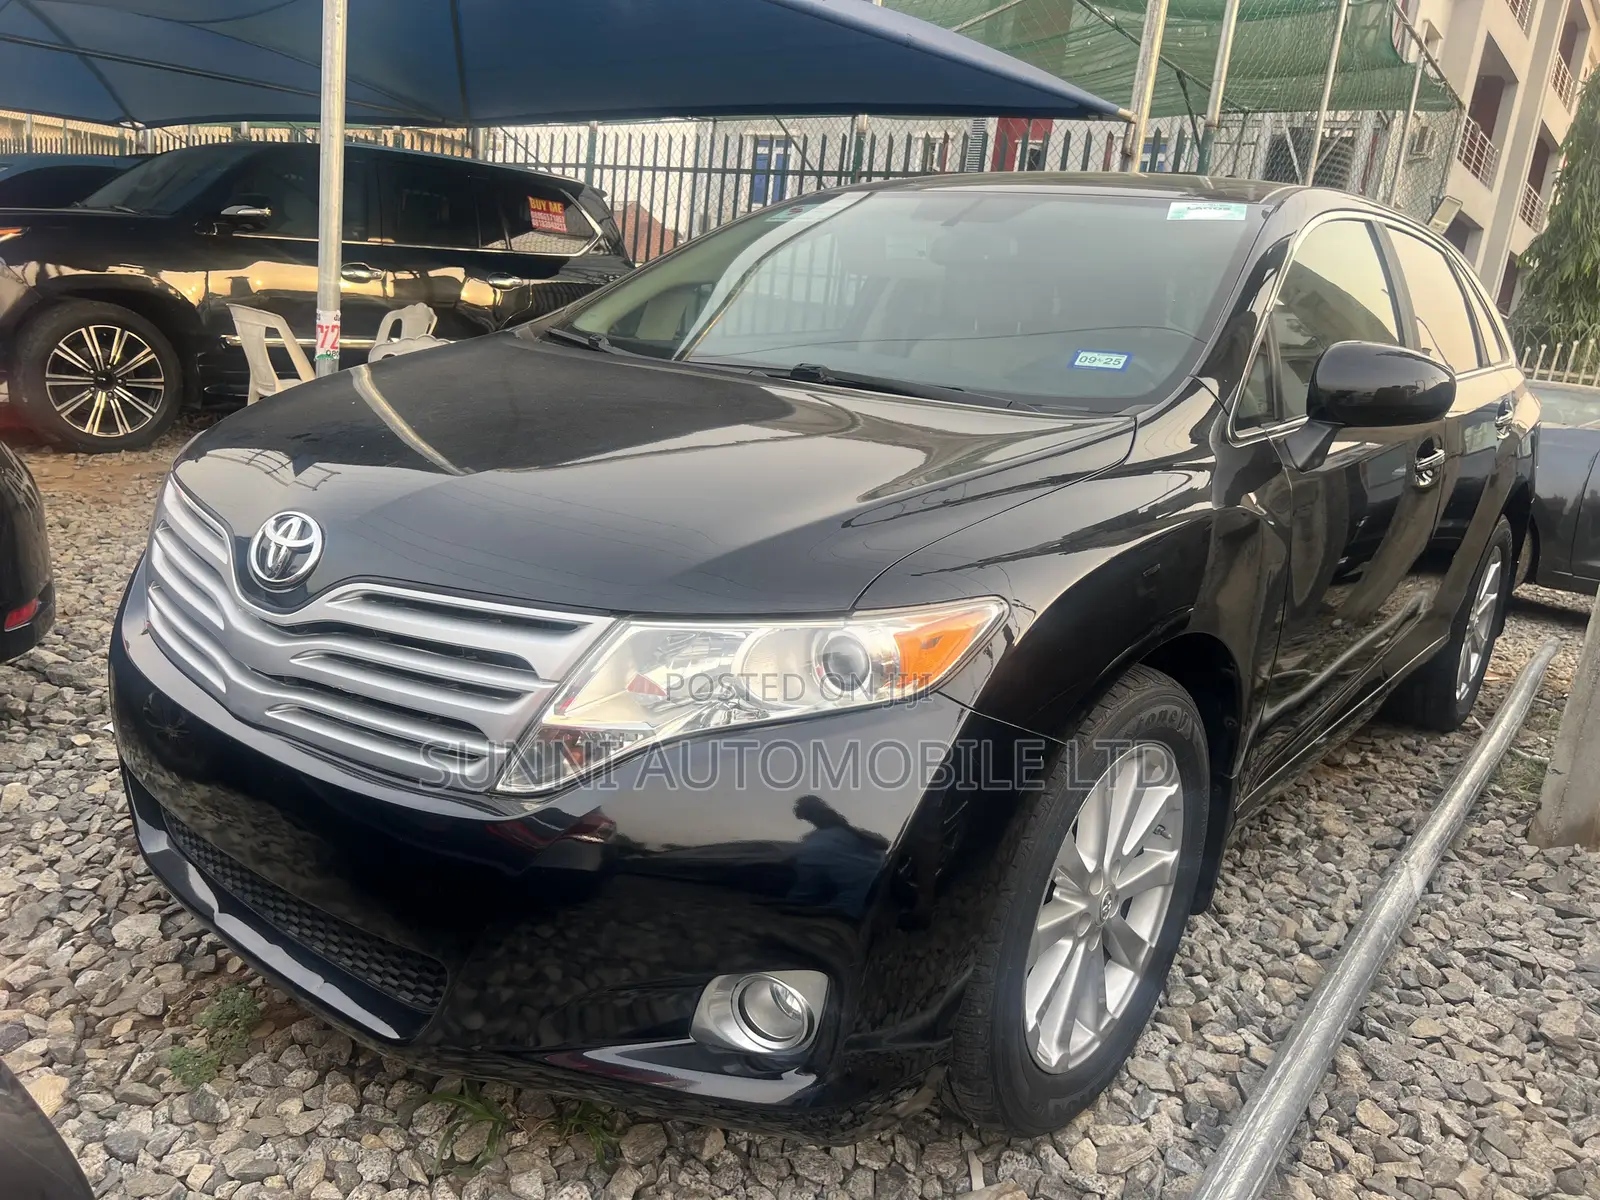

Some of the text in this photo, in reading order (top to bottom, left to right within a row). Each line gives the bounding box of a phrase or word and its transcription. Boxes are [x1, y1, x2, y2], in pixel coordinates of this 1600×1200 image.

[529, 198, 564, 214] BUY ME
[1078, 355, 1123, 366] 09 25
